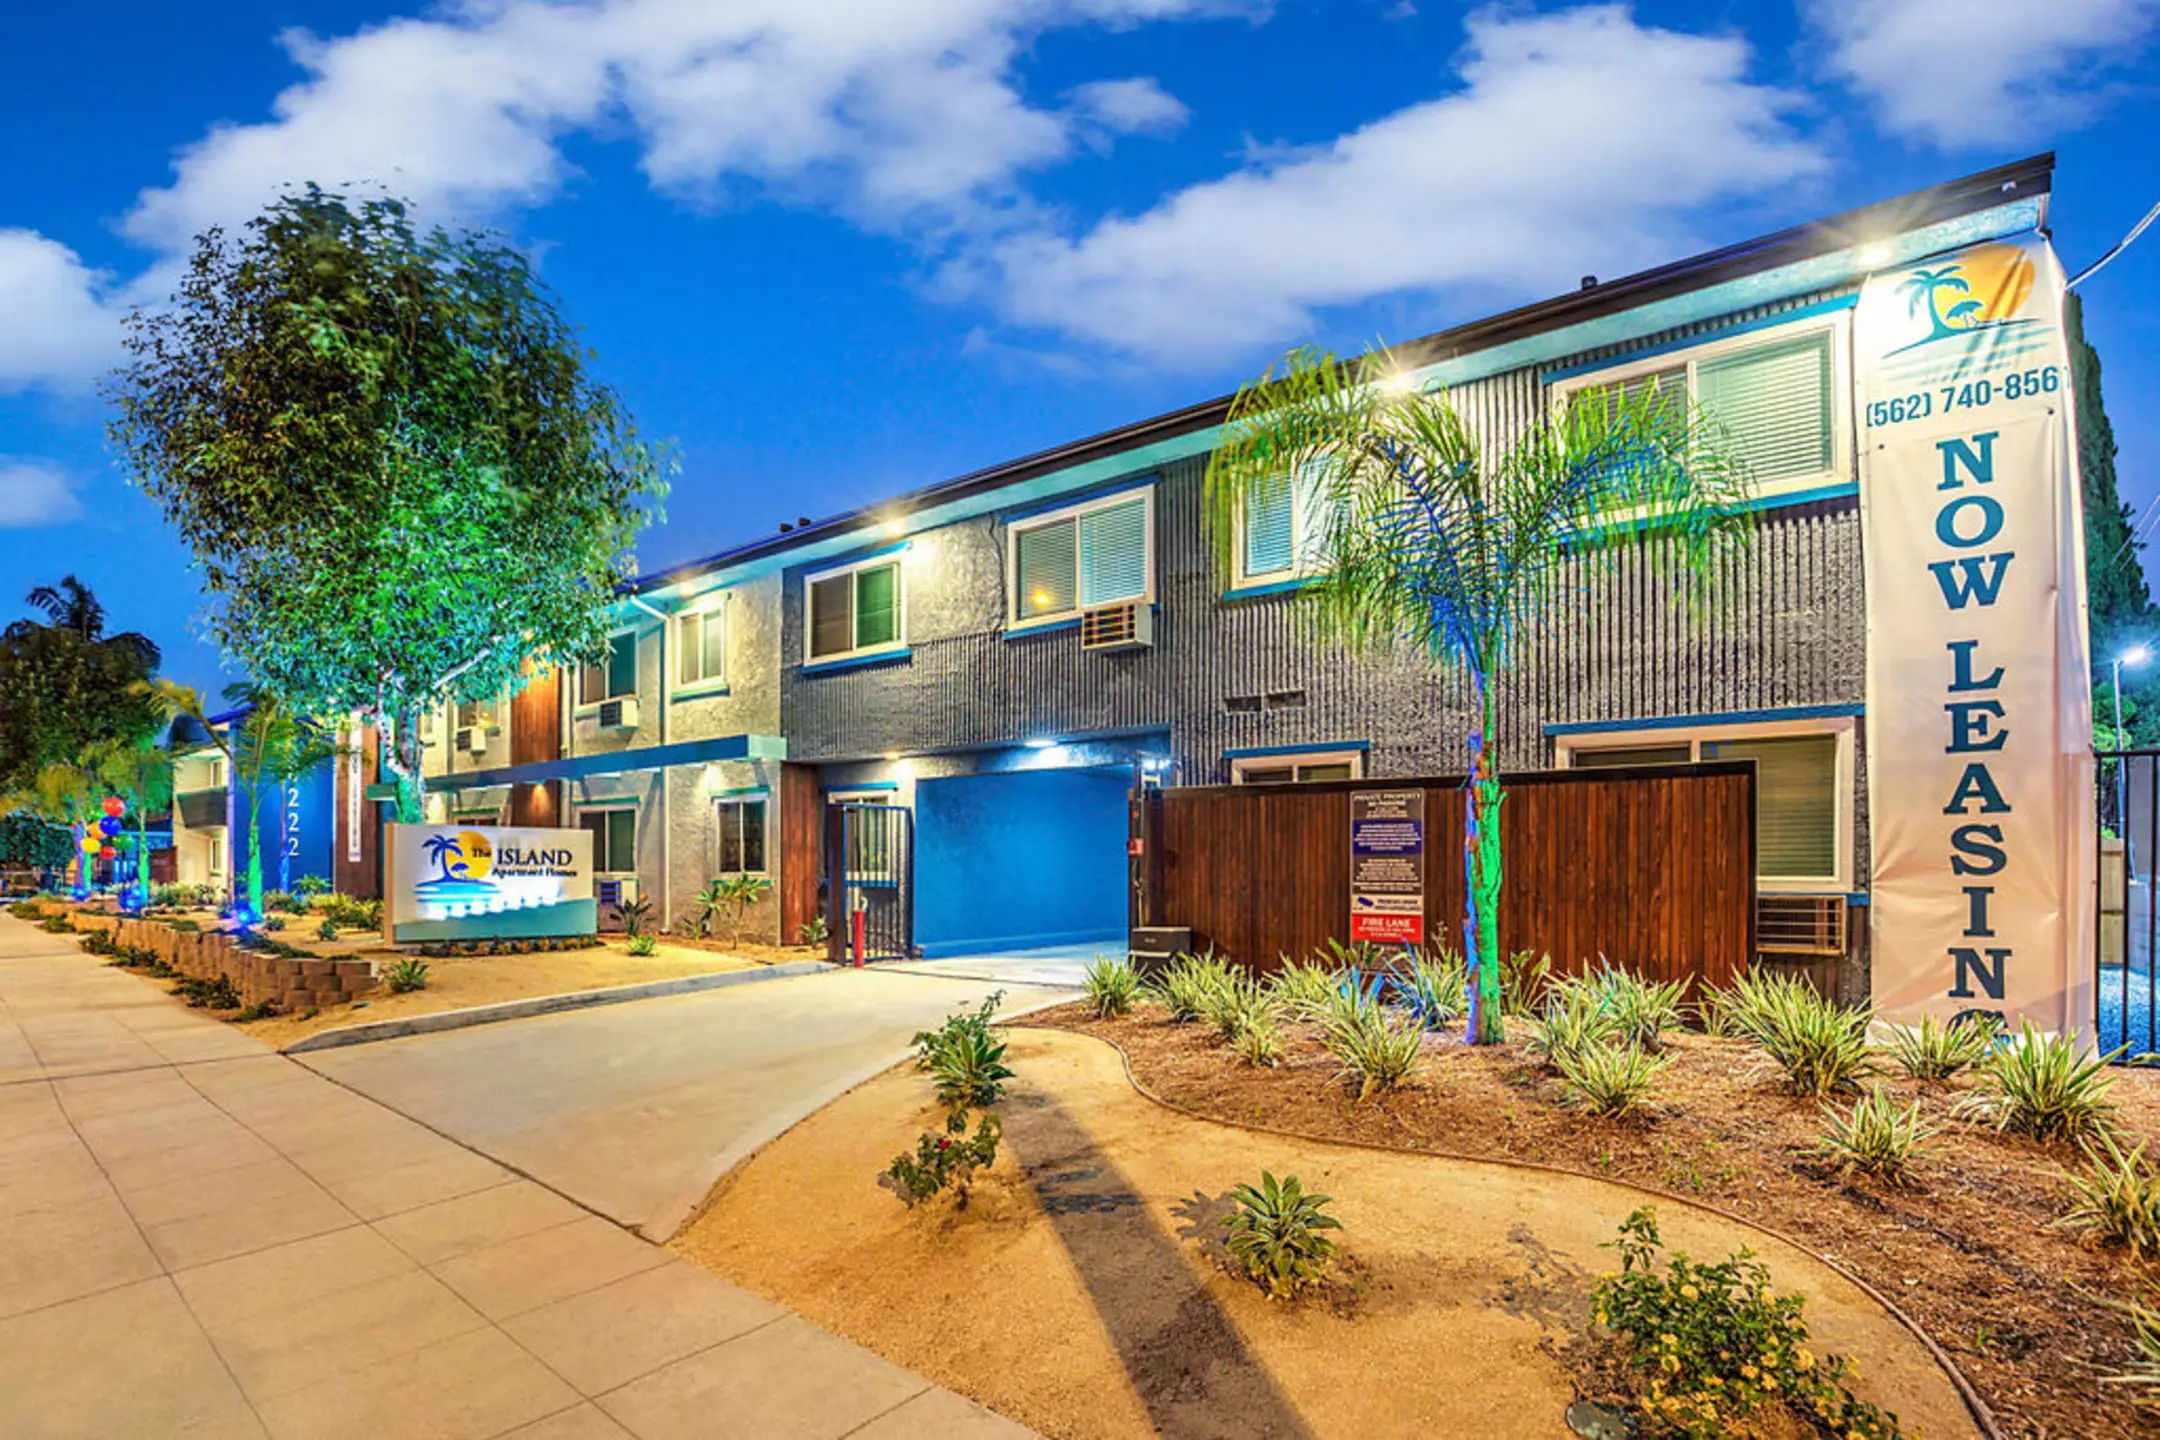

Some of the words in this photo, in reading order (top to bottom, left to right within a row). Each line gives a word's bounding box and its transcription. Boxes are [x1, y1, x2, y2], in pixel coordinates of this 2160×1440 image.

[1866, 392, 1931, 427] (562)
[1928, 431, 2015, 611] NOW
[472, 847, 492, 858] The
[497, 848, 573, 866] ISLAND
[491, 867, 544, 879] Apartment
[546, 868, 578, 877] Homes
[1362, 918, 1384, 927] FIRE
[1385, 919, 1411, 928] LANE
